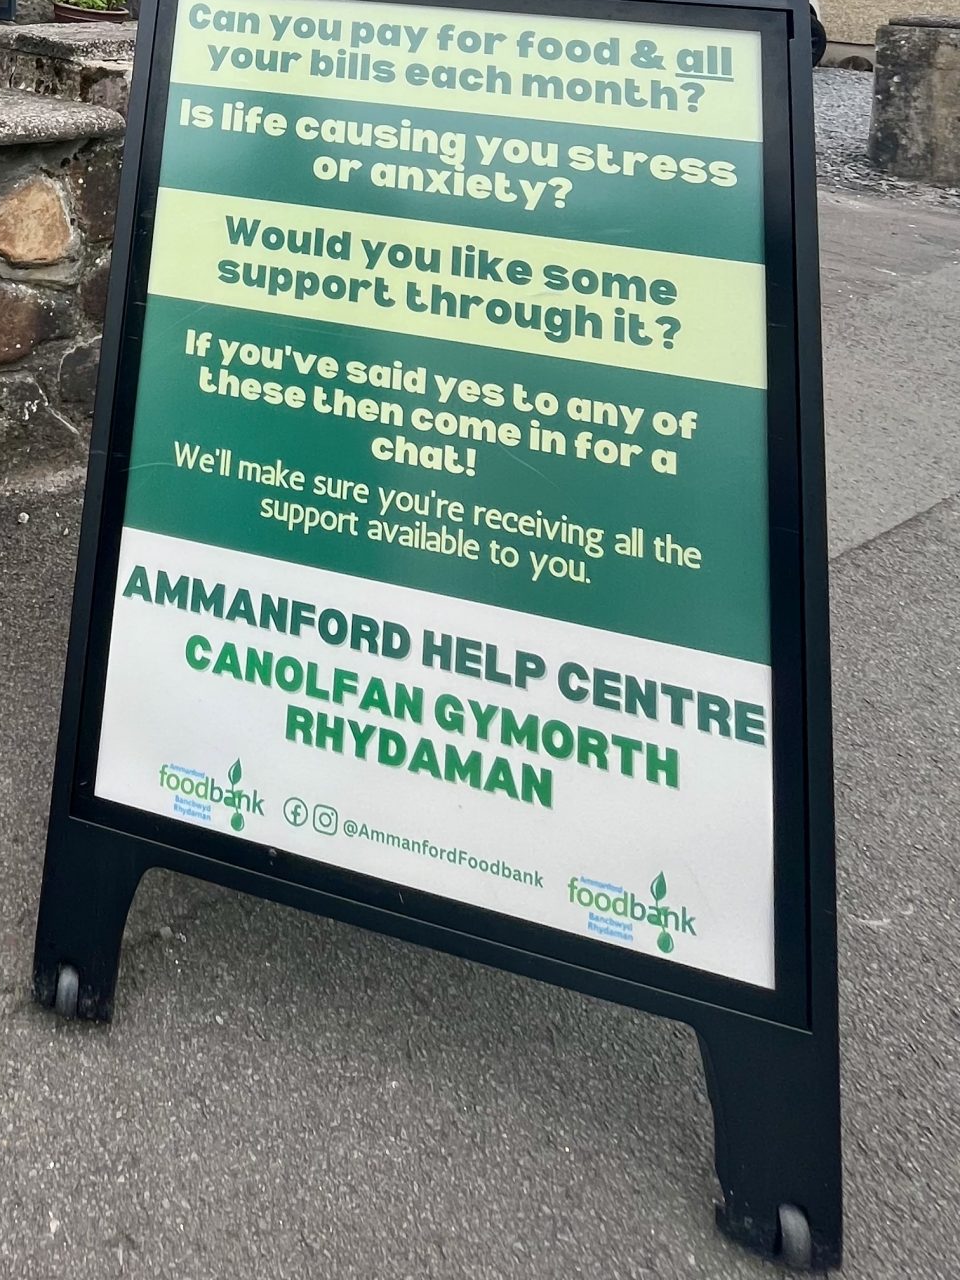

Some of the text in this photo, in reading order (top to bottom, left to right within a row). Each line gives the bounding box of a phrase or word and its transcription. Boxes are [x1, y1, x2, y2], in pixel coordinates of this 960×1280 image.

[188, 3, 733, 82] Can you pay for food & all
[208, 44, 706, 113] your bills each month?
[180, 98, 737, 187] Is life causing you stress
[313, 152, 572, 211] or anxiety?
[217, 258, 681, 350] support through it?
[225, 216, 678, 305] Would you like some
[185, 330, 697, 439] If you've said yes to any of
[199, 366, 677, 475] these then come in for a
[371, 435, 476, 476] chat!
[174, 441, 703, 568] We'll make sure you're receiving all the
[260, 496, 591, 584] support available to you.
[122, 565, 765, 745] AMMANFORD HELP CENTRE
[185, 634, 678, 788] CANOLFAN GYMORTH
[159, 764, 264, 816] foodbank
[285, 704, 552, 808] RHYDAMAN
[343, 820, 543, 888] @AmmanfordFoodbank
[568, 876, 696, 936] foodbank
